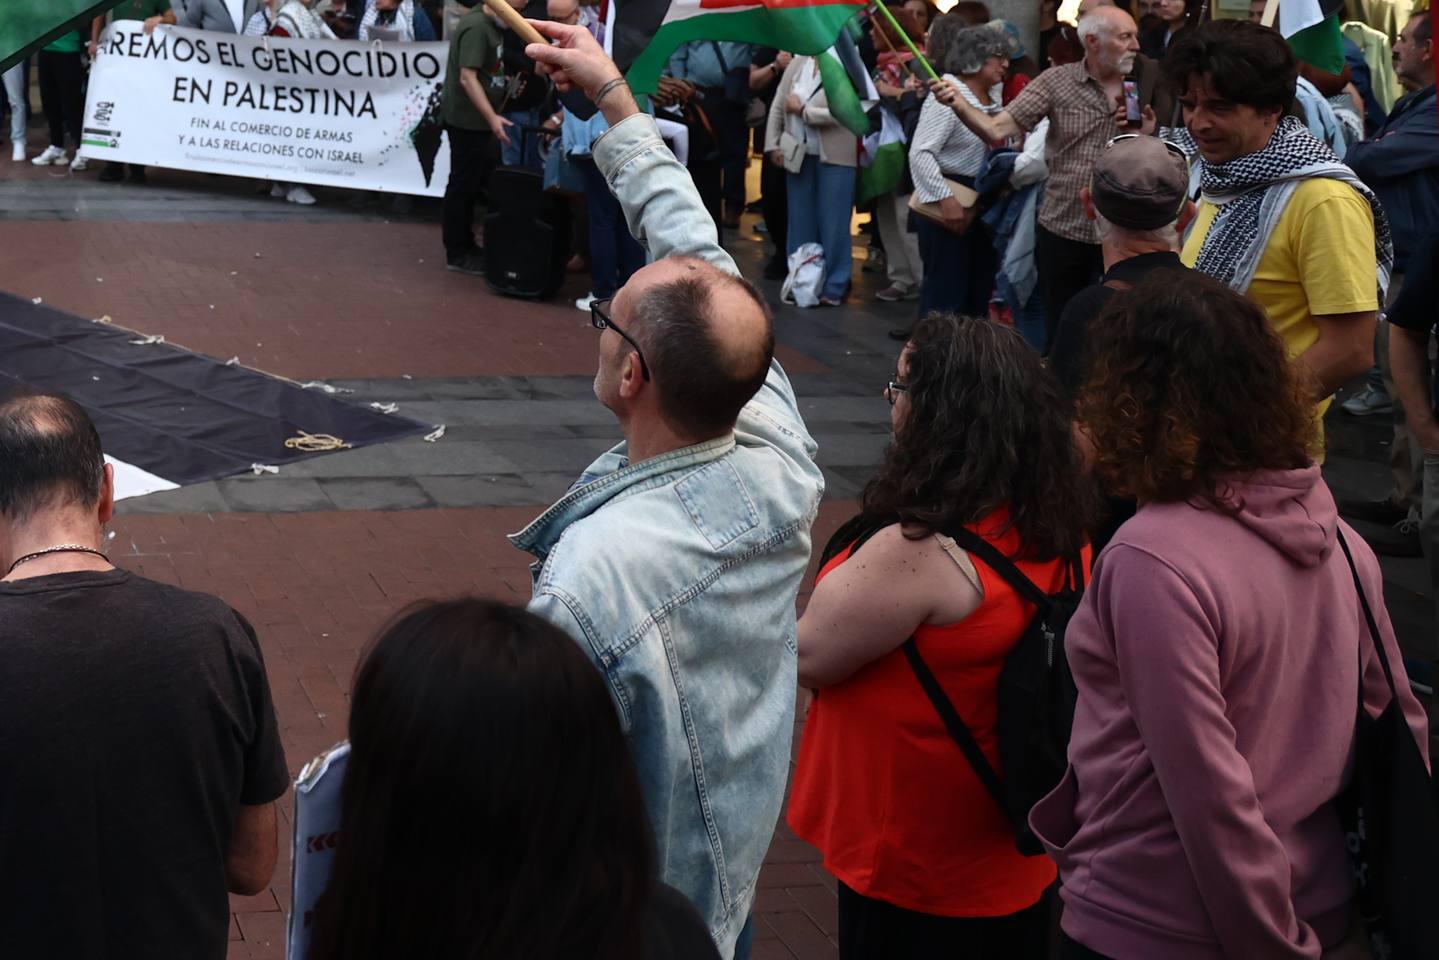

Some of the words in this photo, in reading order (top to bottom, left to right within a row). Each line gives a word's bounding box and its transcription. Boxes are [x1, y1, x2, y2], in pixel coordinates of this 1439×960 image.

[217, 41, 245, 68] EL
[252, 46, 440, 79] GENOCIDIO
[172, 77, 213, 104] EN
[222, 80, 377, 119] PALESTINA
[191, 117, 210, 129] FIN
[213, 120, 226, 131] AL
[230, 121, 293, 138] COMERCIO
[296, 127, 311, 139] DE
[313, 129, 353, 143] ARMAS
[178, 134, 185, 144] Y
[188, 136, 196, 146] A
[200, 137, 220, 149] LAS
[223, 139, 294, 157] RELACIONES
[297, 147, 324, 159] CON
[327, 149, 364, 164] ISRAEL
